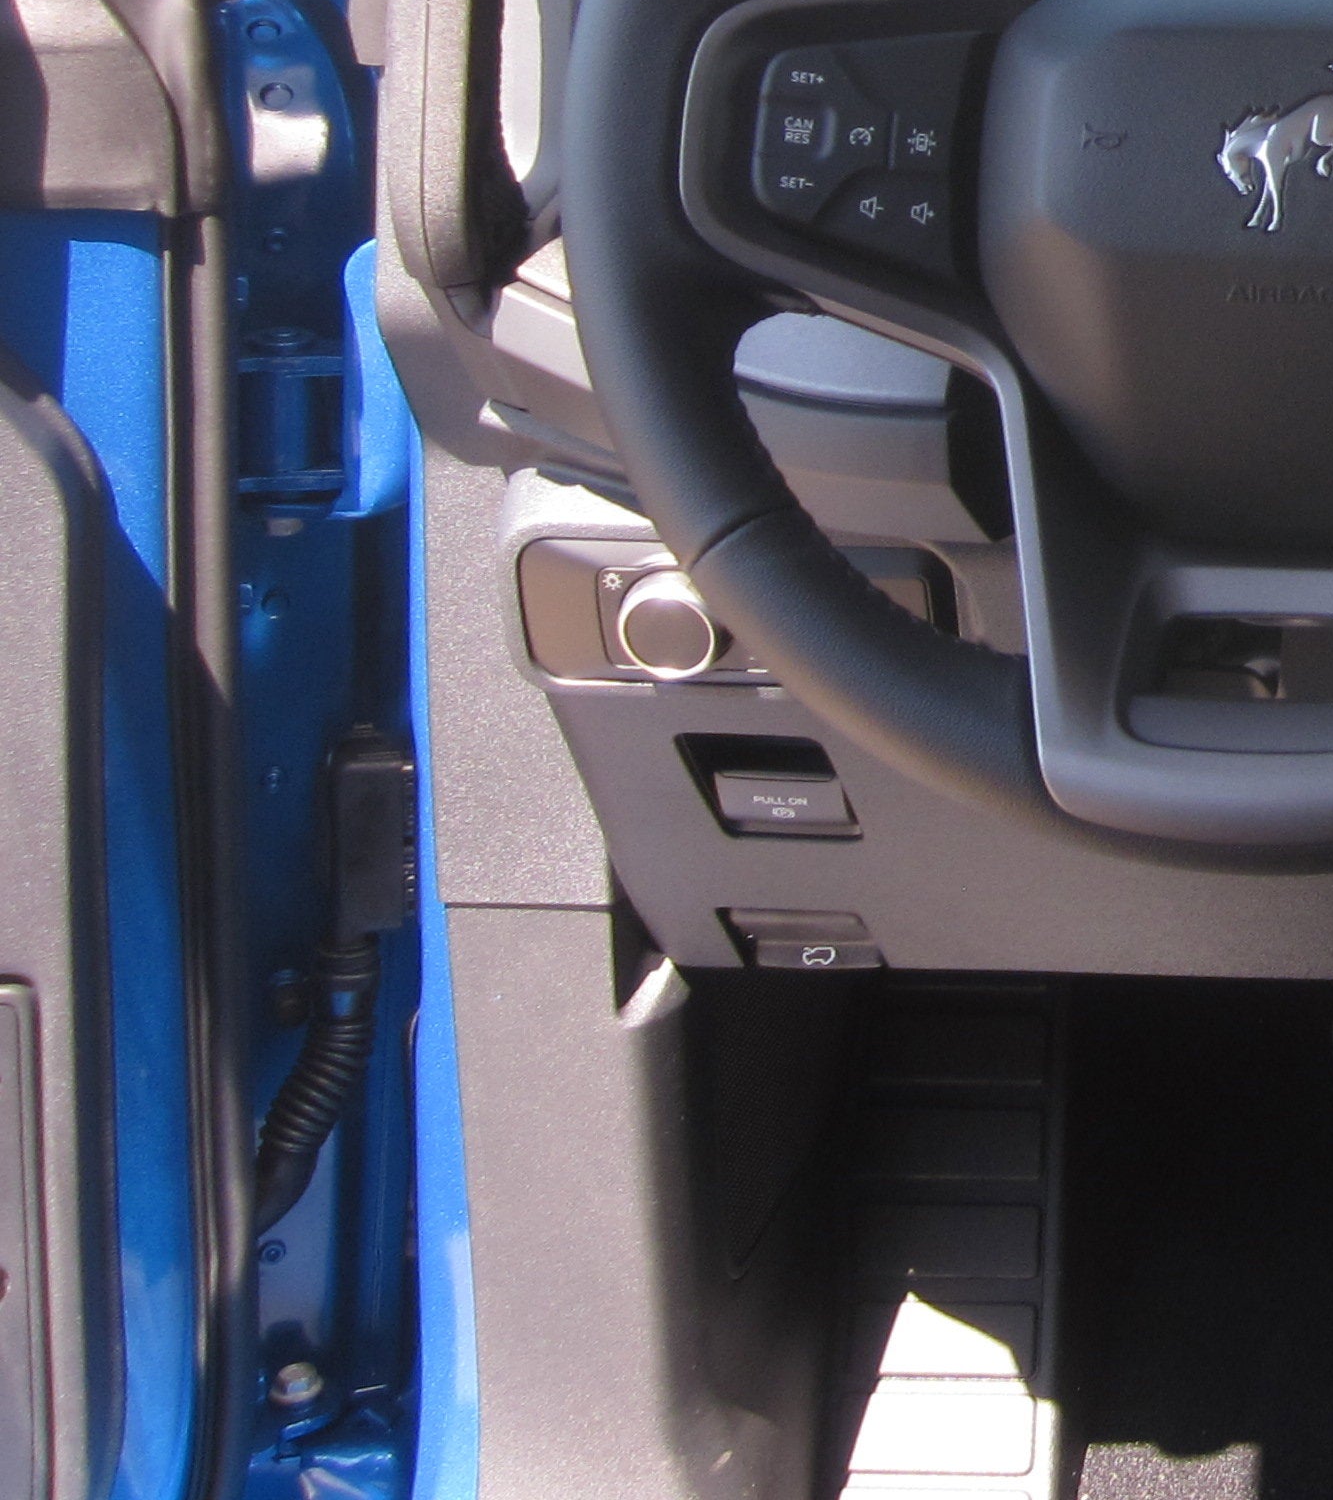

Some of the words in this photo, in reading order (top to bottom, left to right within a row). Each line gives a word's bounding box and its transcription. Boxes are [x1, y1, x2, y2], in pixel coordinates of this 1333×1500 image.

[790, 70, 825, 85] SET+
[784, 116, 815, 131] CAN
[783, 132, 812, 145] RES
[753, 795, 786, 806] PULL
[788, 796, 809, 807] ON
